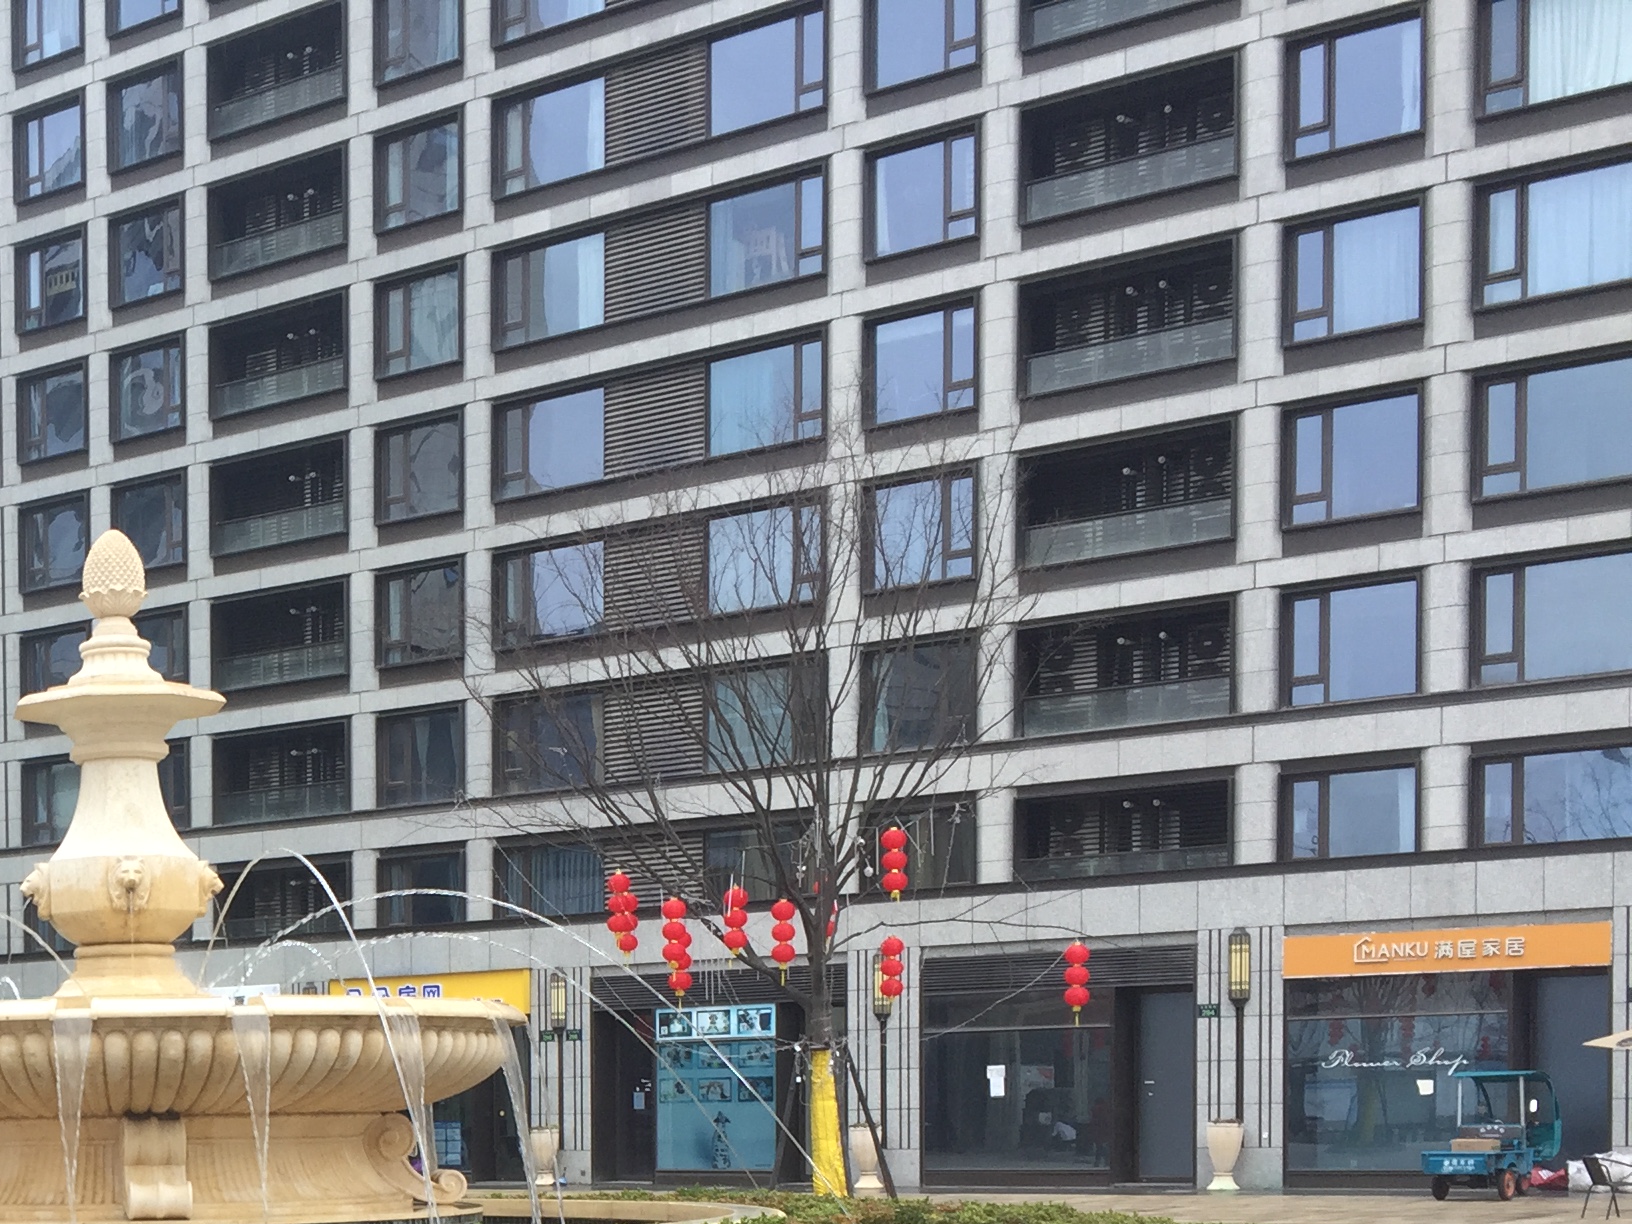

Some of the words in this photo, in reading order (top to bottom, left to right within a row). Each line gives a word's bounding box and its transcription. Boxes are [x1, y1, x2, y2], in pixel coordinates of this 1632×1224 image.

[1361, 941, 1428, 959] MANKU
[1434, 937, 1525, 959] 满屋家居
[1406, 1047, 1469, 1076] Shop
